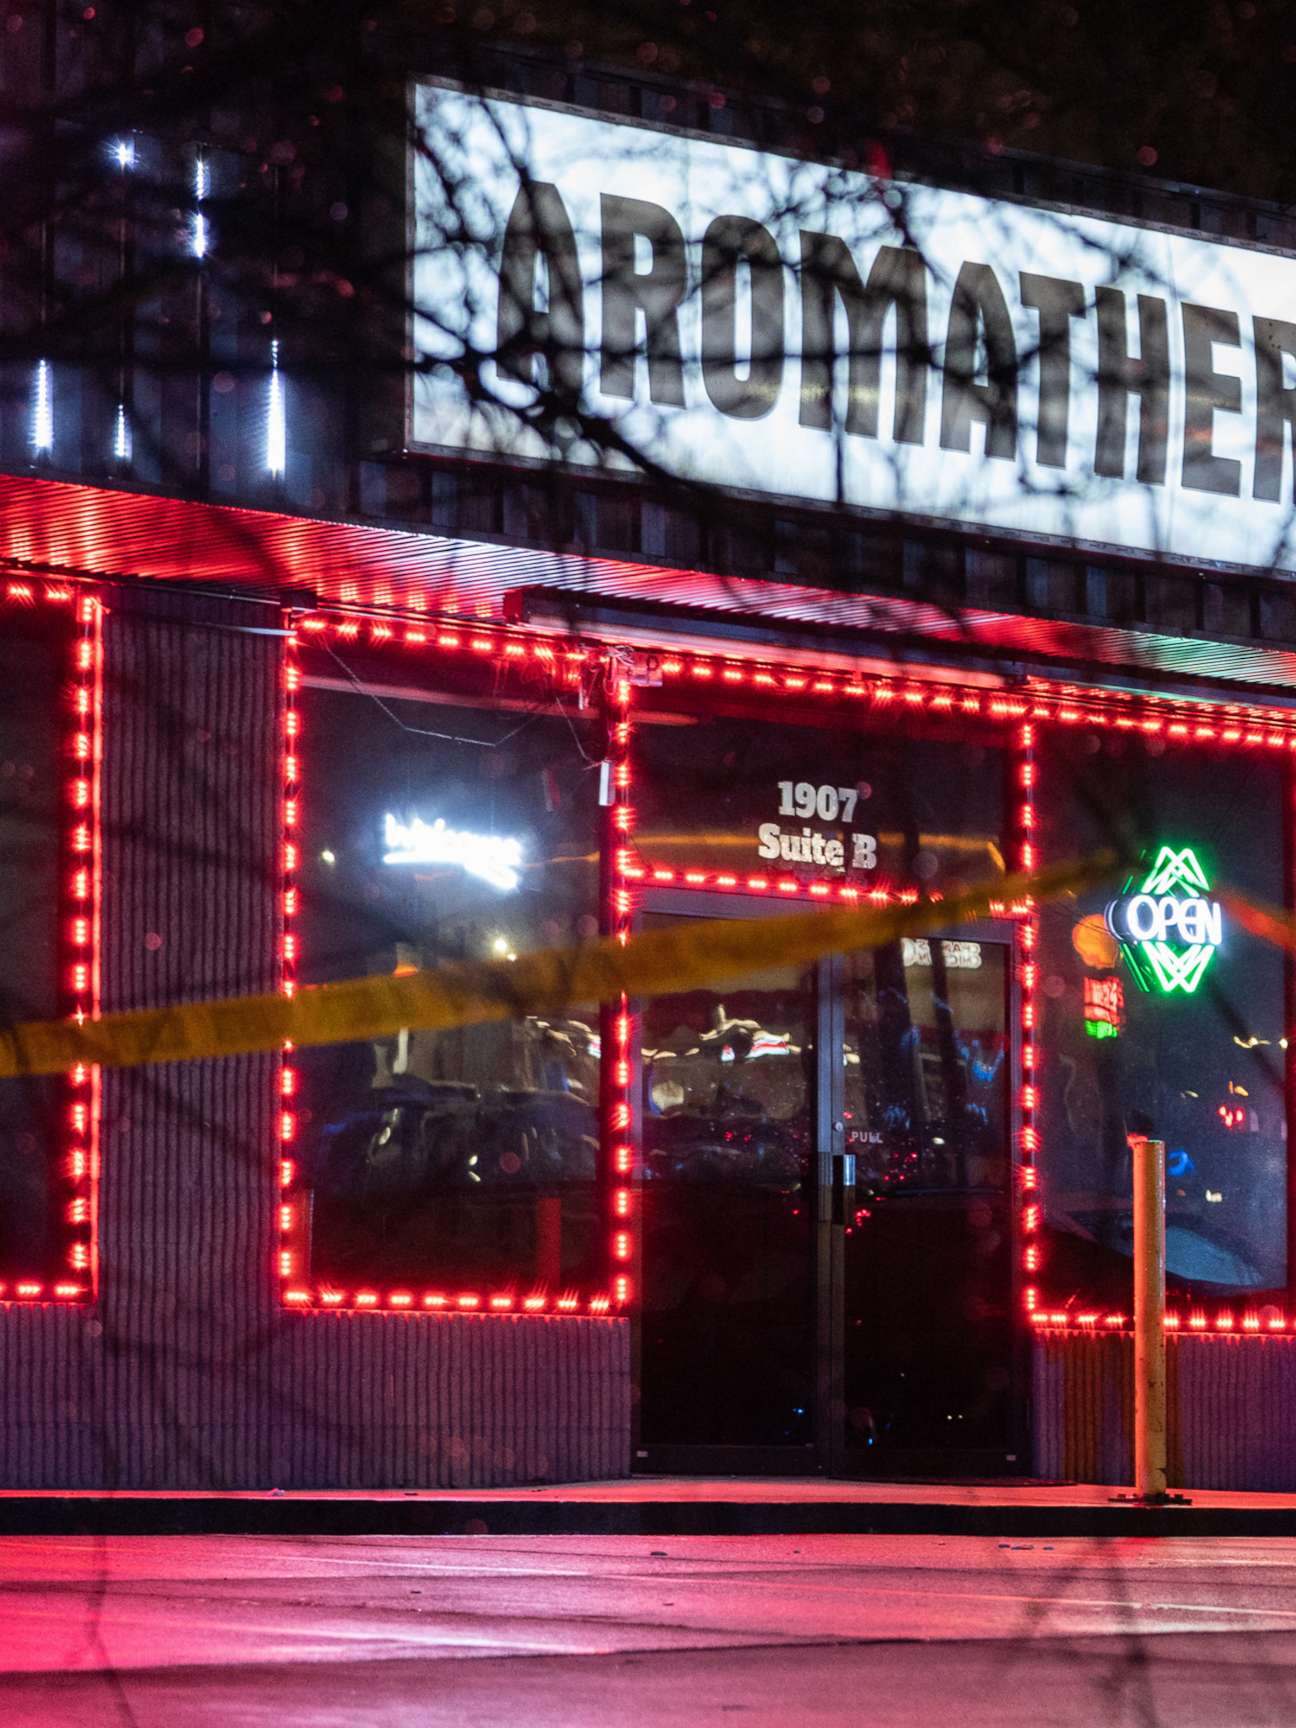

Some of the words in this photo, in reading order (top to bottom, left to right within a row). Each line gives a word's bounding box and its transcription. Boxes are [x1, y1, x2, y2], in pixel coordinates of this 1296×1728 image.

[778, 781, 859, 823] 1907
[758, 823, 846, 872] Suite
[852, 833, 877, 869] B
[1126, 894, 1223, 945] OPEN
[850, 1131, 883, 1143] PULL
